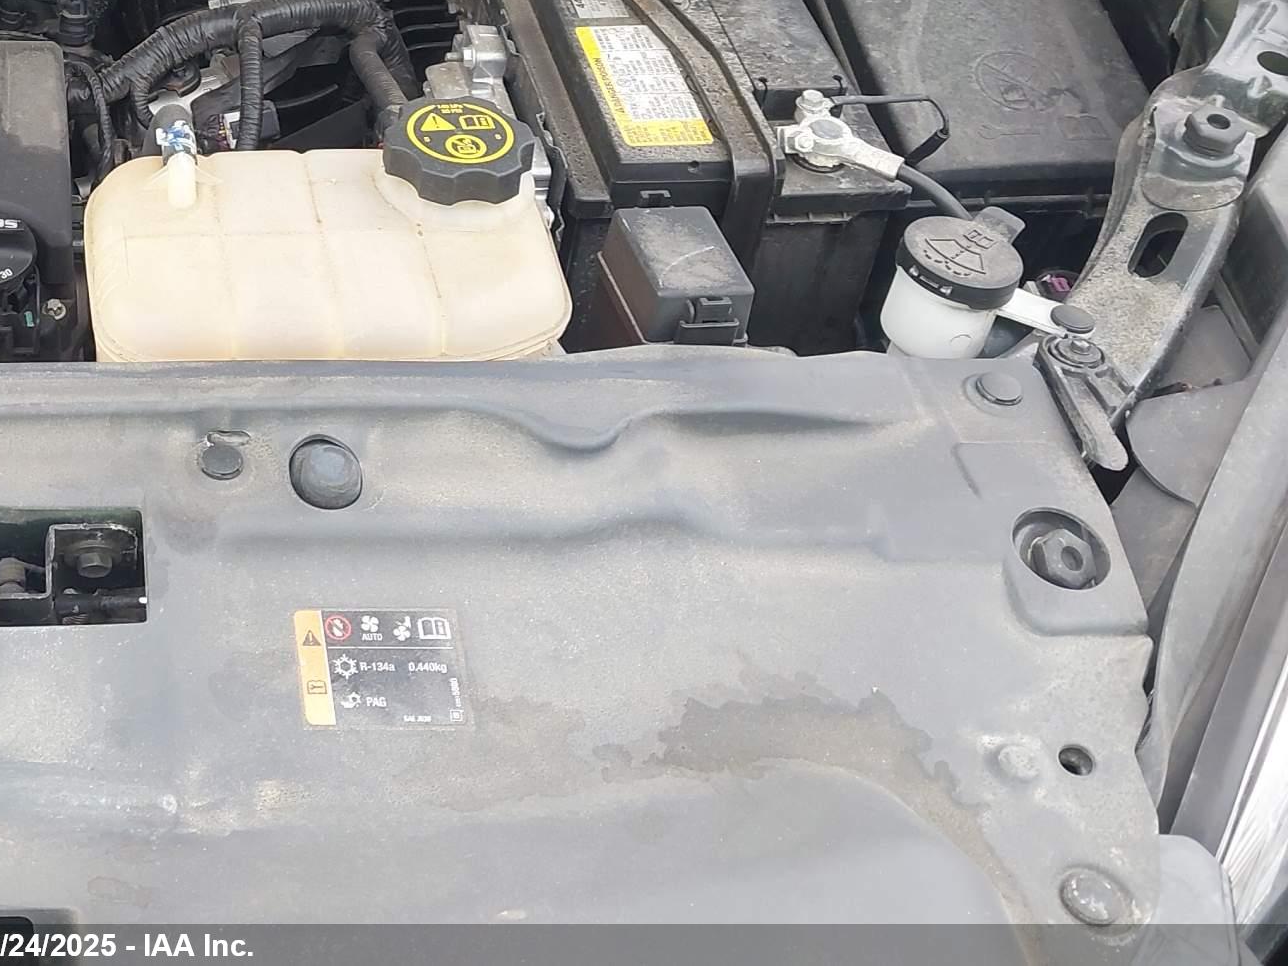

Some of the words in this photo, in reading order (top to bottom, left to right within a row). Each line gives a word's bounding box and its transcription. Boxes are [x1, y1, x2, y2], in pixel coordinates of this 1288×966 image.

[361, 634, 383, 642] AUTO
[359, 661, 396, 672] R-134a
[365, 696, 387, 708] PAG
